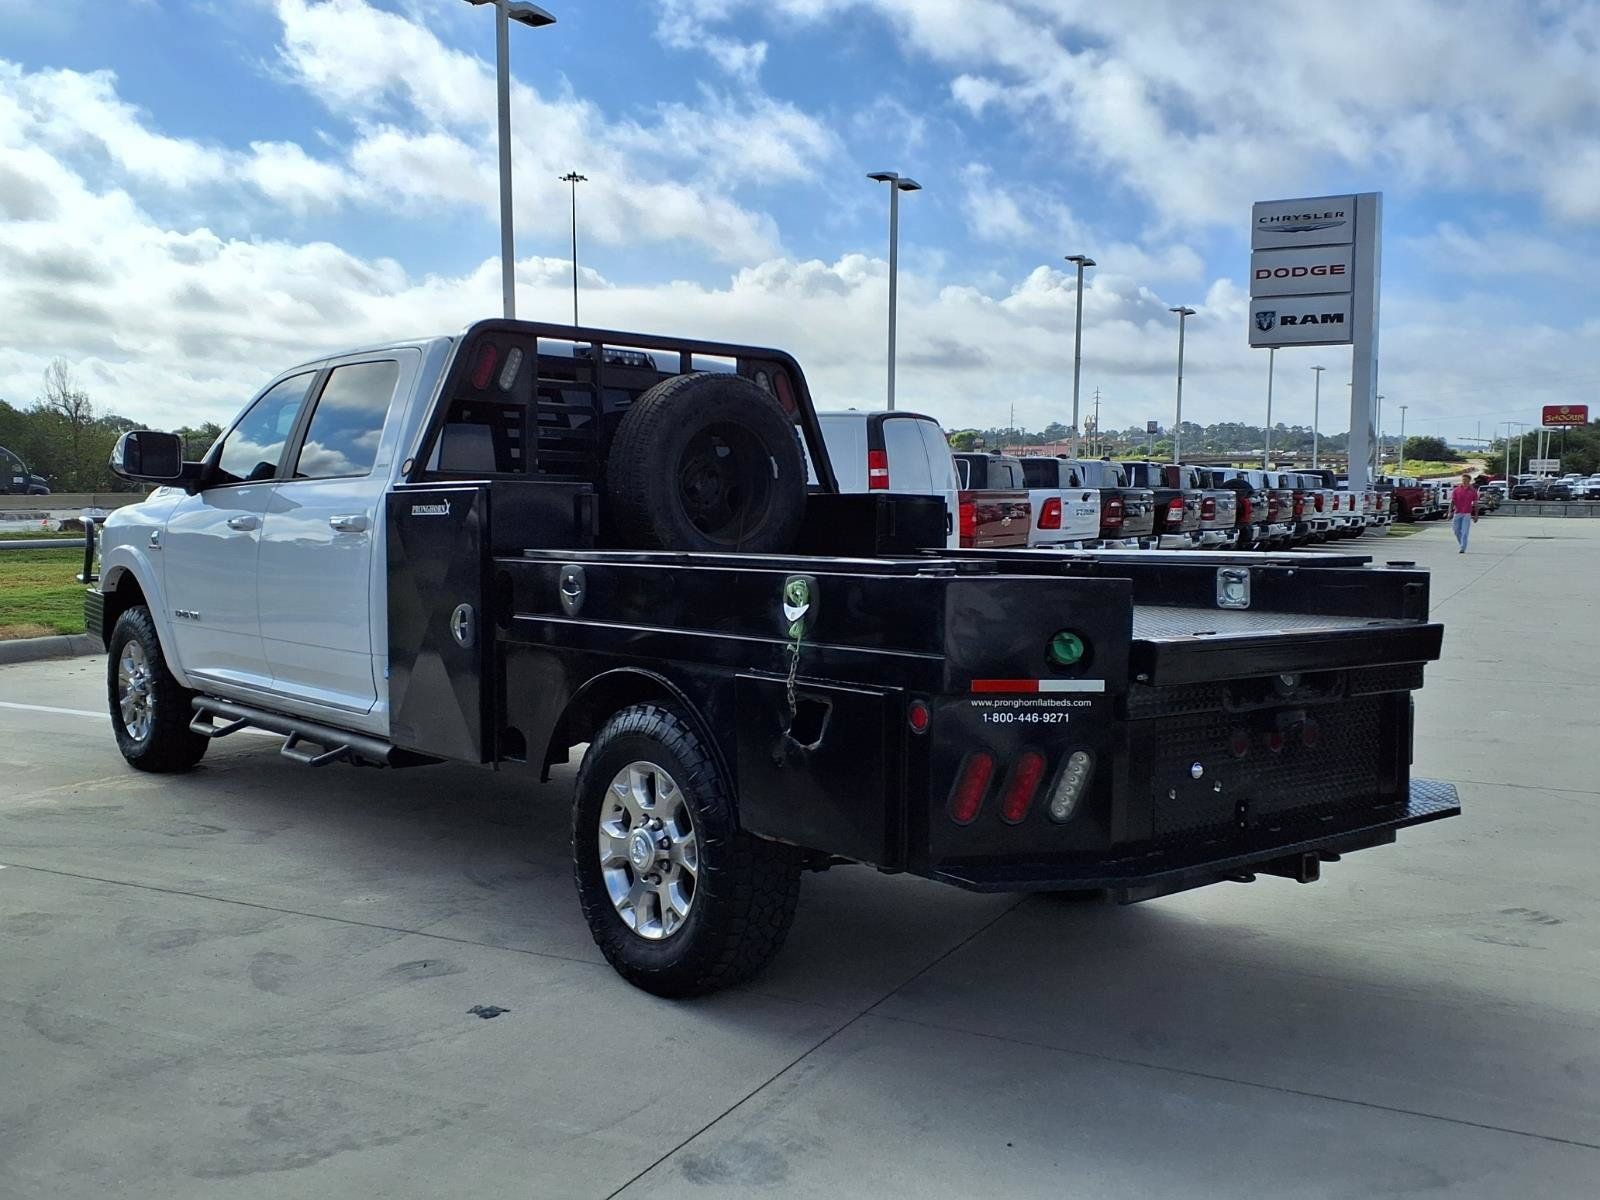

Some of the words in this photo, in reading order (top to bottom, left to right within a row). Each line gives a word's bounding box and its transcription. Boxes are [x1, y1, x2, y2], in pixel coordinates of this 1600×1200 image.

[1259, 211, 1345, 223] CHRYSLER
[1255, 264, 1346, 280] DODGE
[1280, 313, 1344, 325] RAM
[971, 699, 1092, 708] www.pronghornflatbeds.com
[983, 713, 1069, 723] 1-800-446-9271
